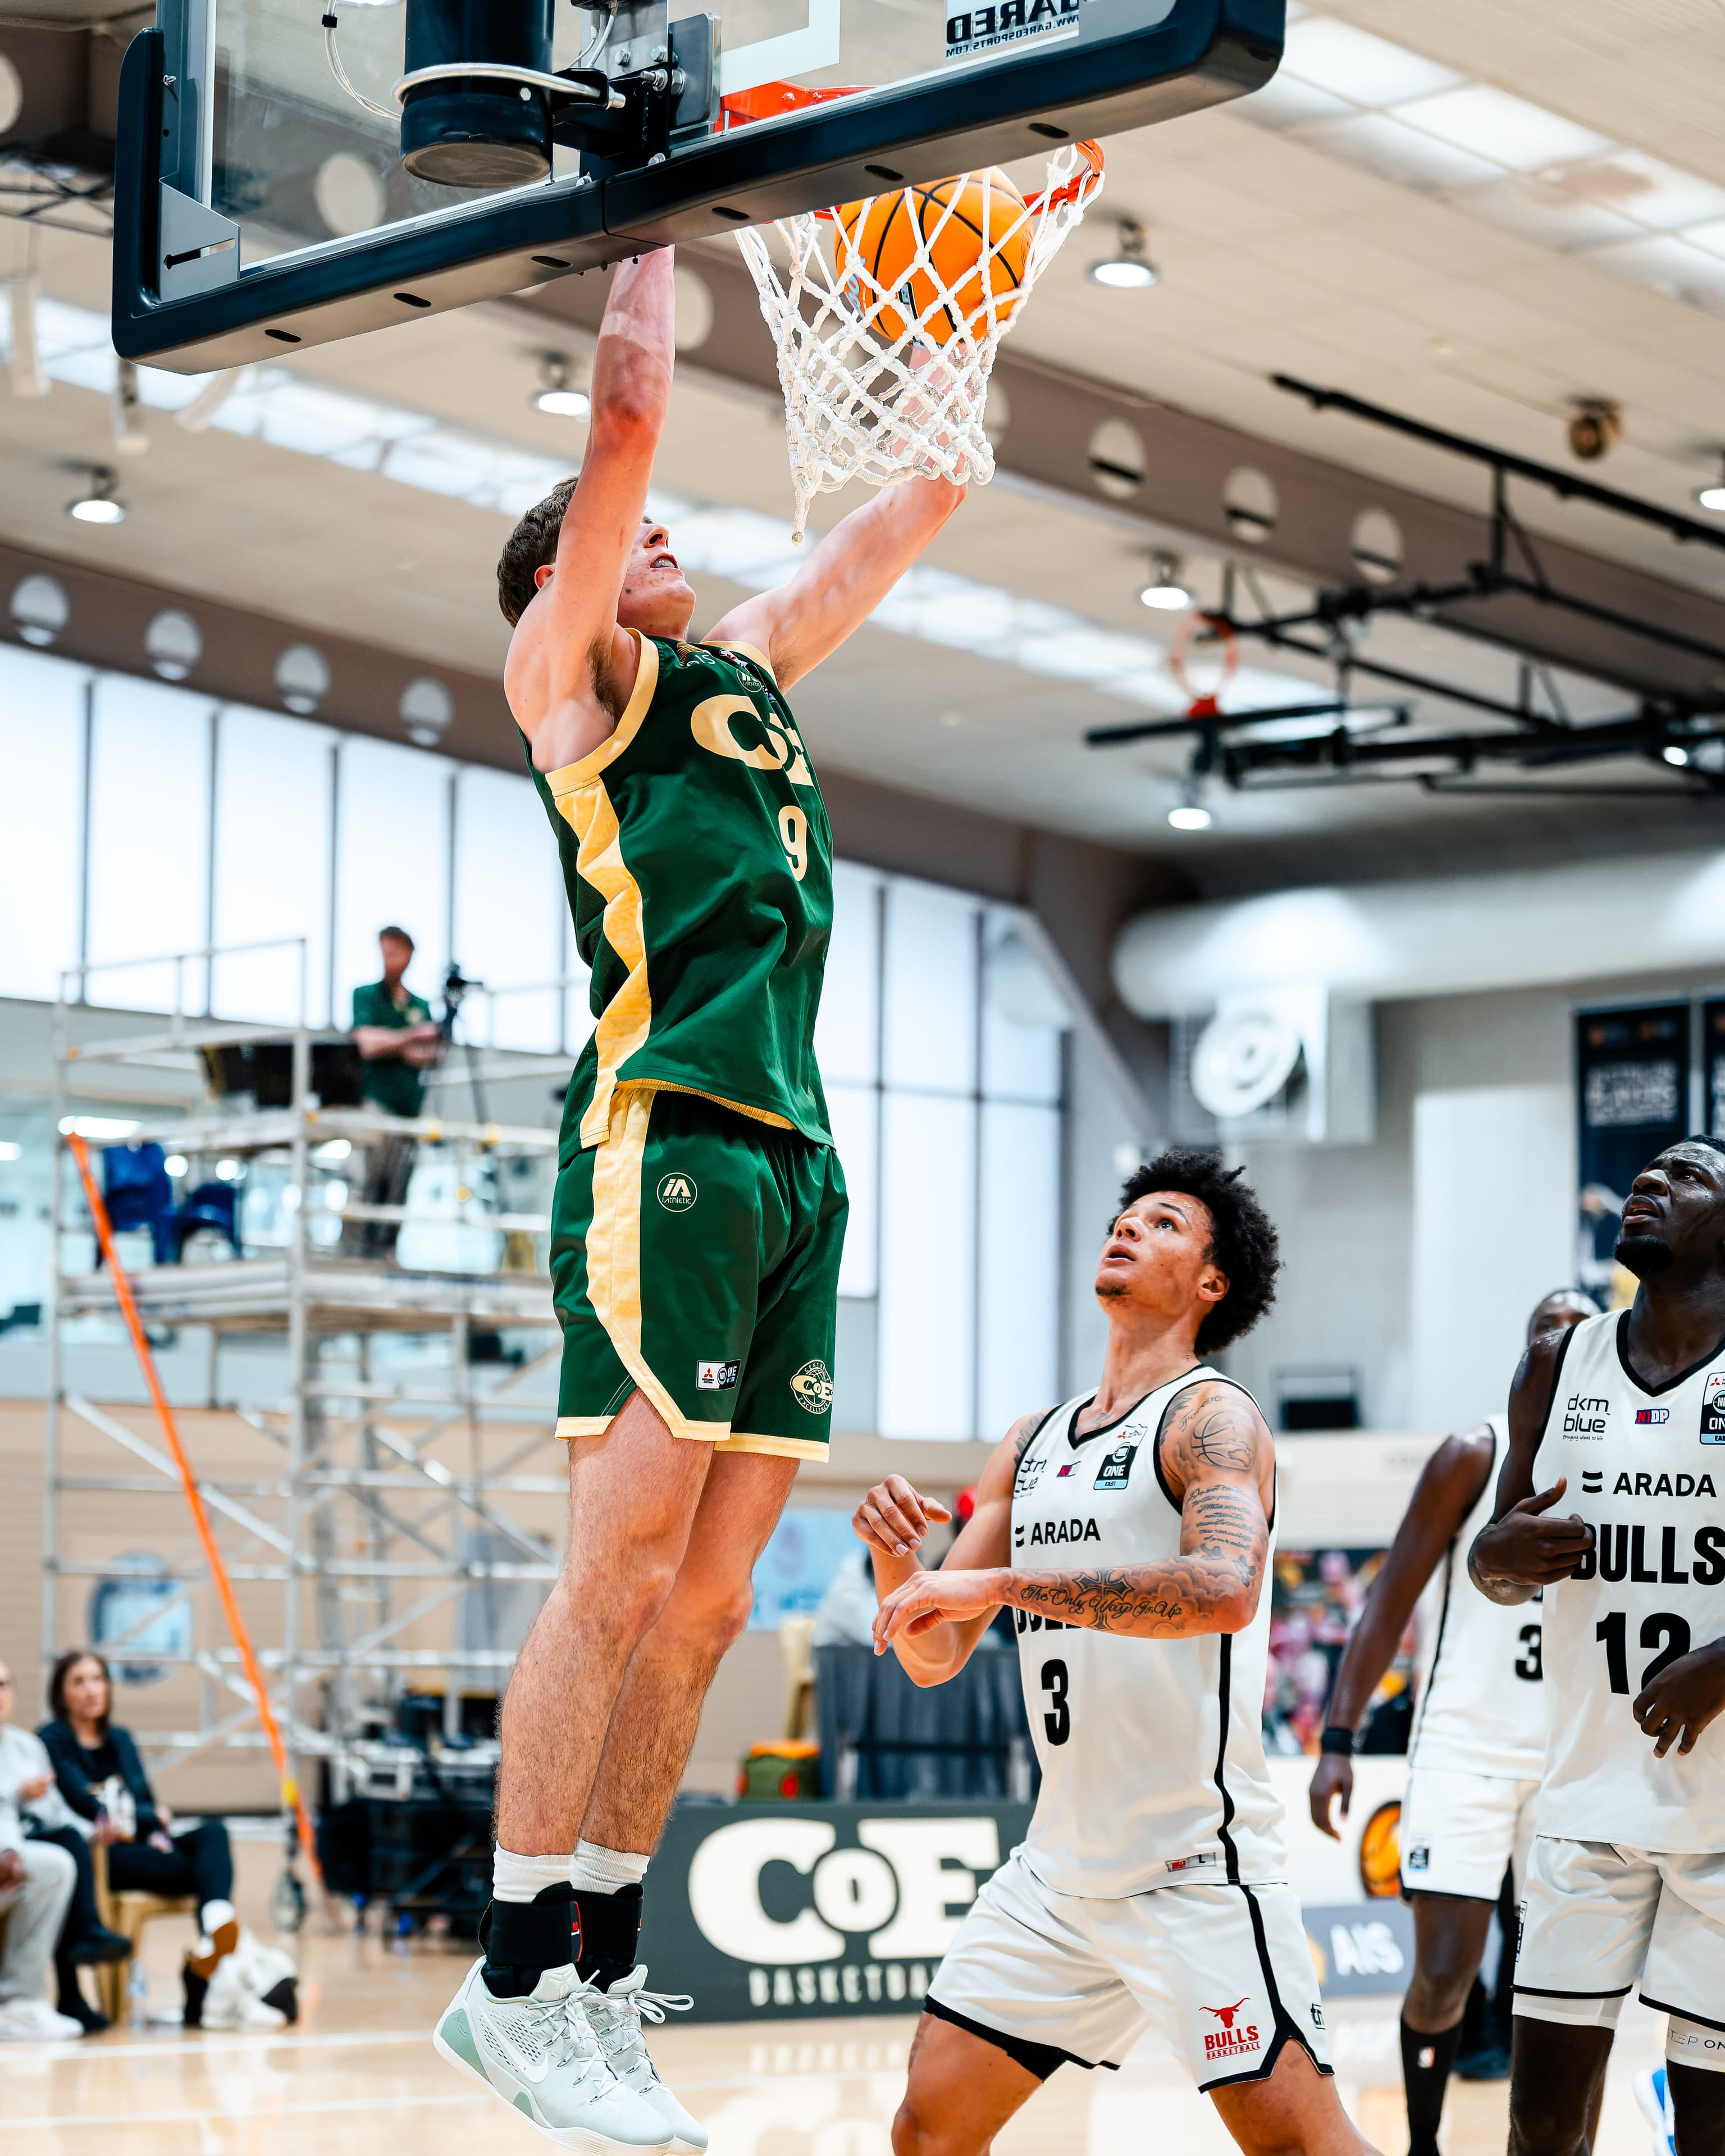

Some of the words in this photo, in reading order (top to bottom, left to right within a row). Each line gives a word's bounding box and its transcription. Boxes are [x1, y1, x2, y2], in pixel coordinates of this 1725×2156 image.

[778, 805, 807, 881] 9
[804, 1363, 825, 1373] CENTR
[1568, 1393, 1609, 1413] dkm
[1563, 1413, 1606, 1433] blue
[1636, 1410, 1668, 1423] N1DP
[1103, 1464, 1126, 1477] ONE
[1613, 1472, 1717, 1498] ARADA
[1030, 1518, 1101, 1546] ARADA
[1020, 1584, 1048, 1601] The
[1048, 1588, 1088, 1614] Only
[1089, 1596, 1132, 1619] Way
[1154, 1601, 1183, 1620] Up
[1515, 1624, 1544, 1679] 3
[1596, 1612, 1691, 1694] 12
[1041, 1658, 1070, 1746] 3
[1199, 1854, 1206, 1863] L
[688, 1817, 1000, 1965] CoE
[749, 1963, 942, 2007] BASKETBA
[1204, 2025, 1259, 2050] BULLS
[1207, 2043, 1261, 2059] BASKETBALL
